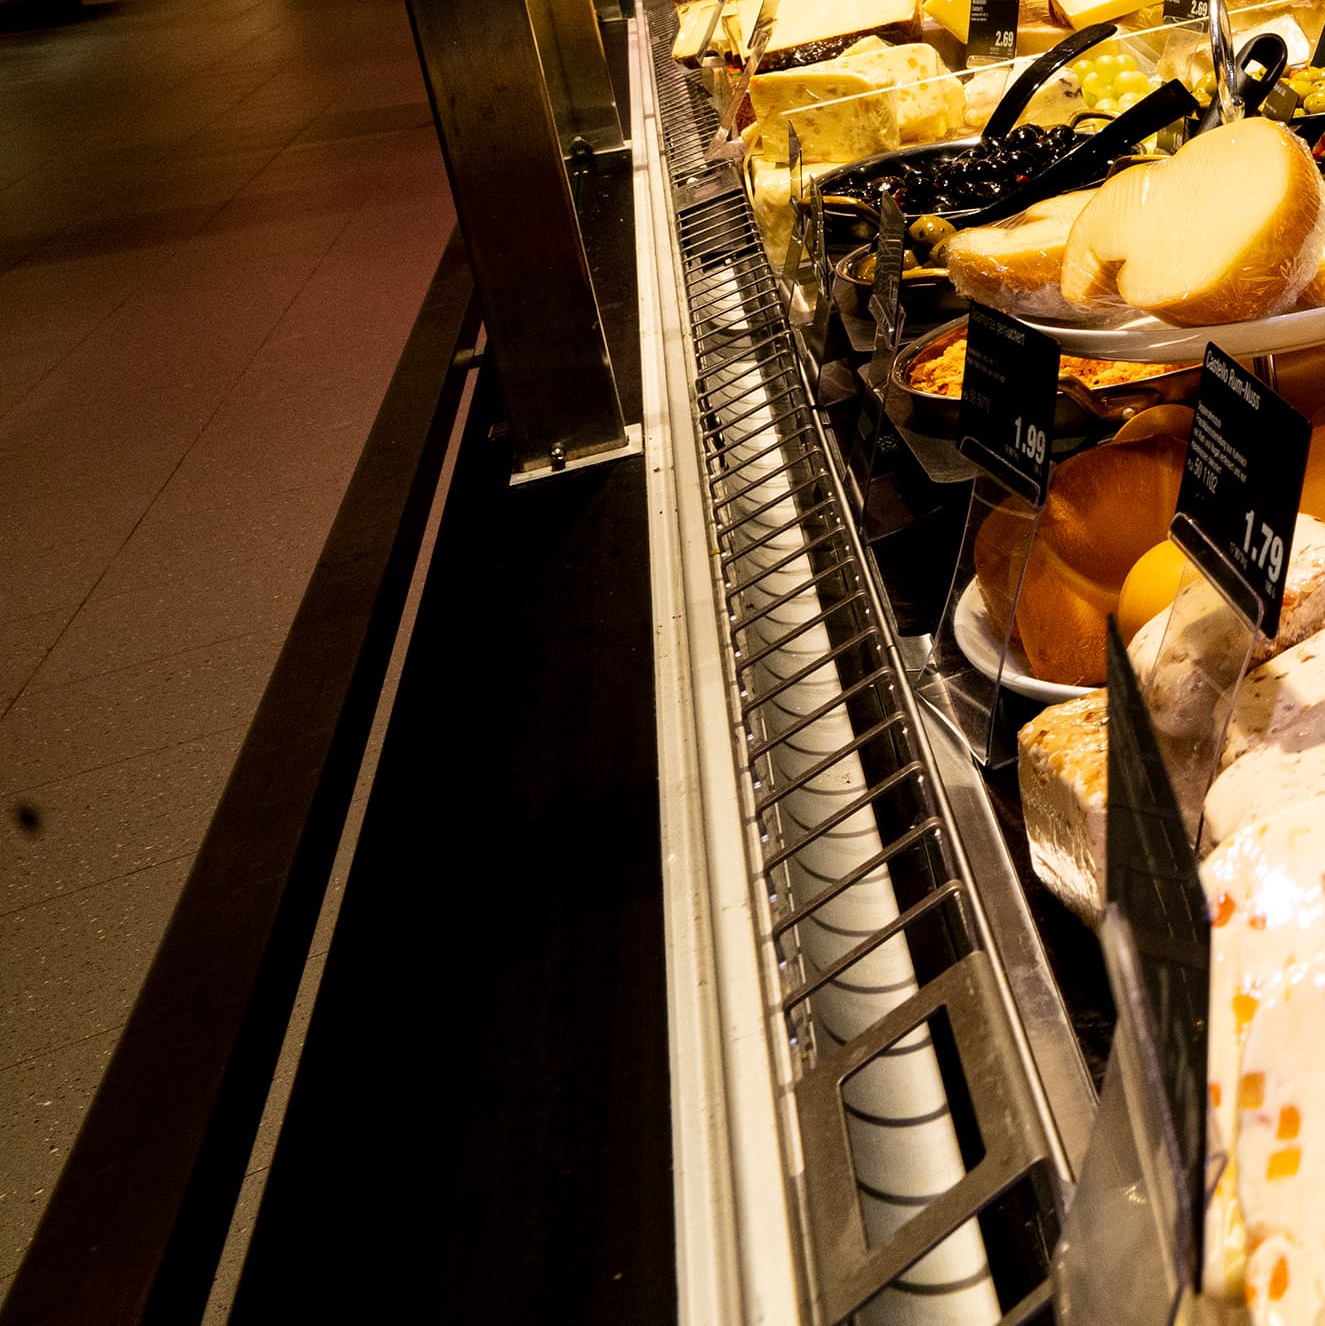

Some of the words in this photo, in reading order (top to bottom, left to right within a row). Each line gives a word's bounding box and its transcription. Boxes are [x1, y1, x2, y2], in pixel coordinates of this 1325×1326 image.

[1191, 0, 1208, 16] 2.69
[995, 31, 1014, 48] 2.69
[1205, 350, 1228, 384] Castello
[1229, 372, 1261, 411] Rum-Nuss
[1015, 416, 1046, 465] 1.99
[1245, 509, 1284, 583] 1.79
